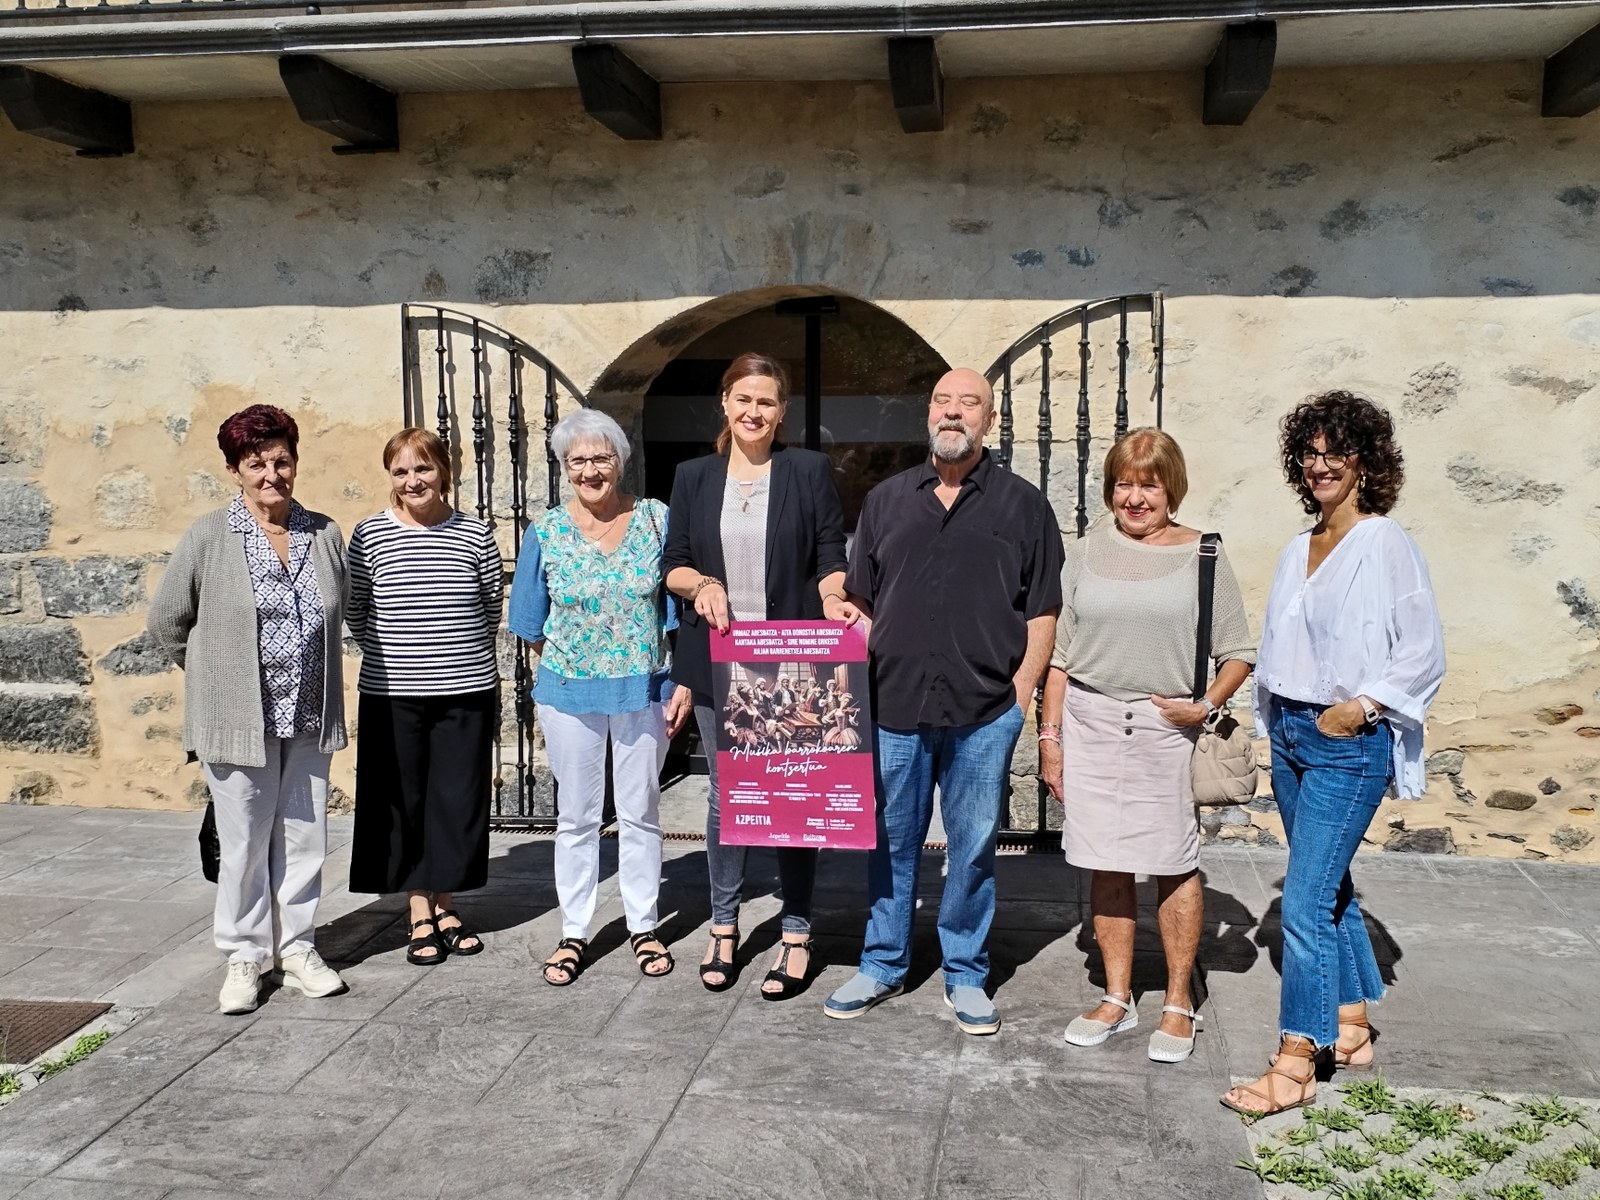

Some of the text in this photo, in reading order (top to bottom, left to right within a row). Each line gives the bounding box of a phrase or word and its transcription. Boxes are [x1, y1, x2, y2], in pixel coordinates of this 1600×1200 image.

[816, 628, 843, 636] ABESBATZA
[735, 638, 757, 646] KANTAKA
[757, 638, 784, 646] ABESBATZA
[753, 647, 770, 655] JULIAN
[803, 647, 831, 655] ABESBATZA
[729, 739, 858, 762] Musika barrokoaren
[765, 757, 828, 778] kontzertua
[735, 814, 772, 826] AZPEITIA
